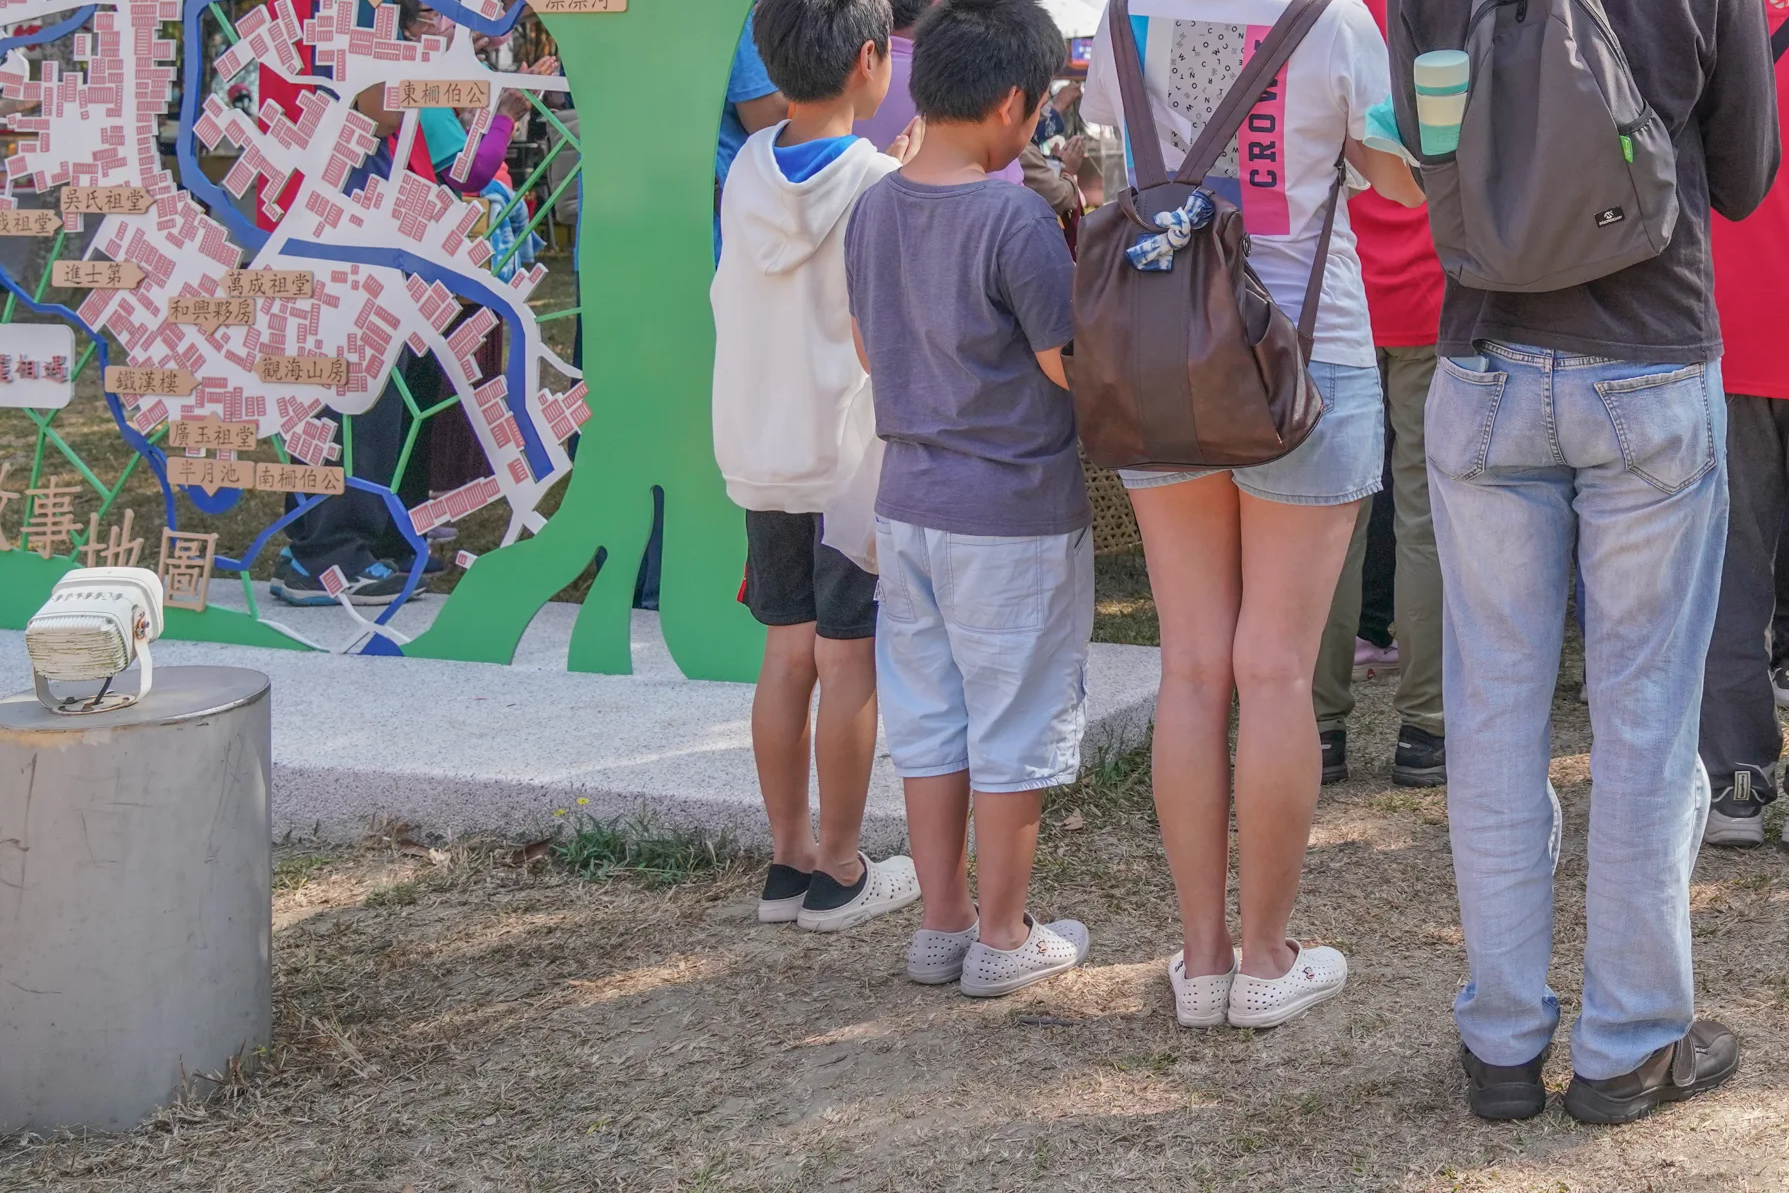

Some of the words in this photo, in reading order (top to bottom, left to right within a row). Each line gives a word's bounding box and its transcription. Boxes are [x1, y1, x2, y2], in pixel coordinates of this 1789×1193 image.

[400, 81, 486, 106] 東柵伯公
[63, 189, 145, 212] 吳氏祖堂
[64, 263, 122, 286] 進士第
[227, 271, 310, 296] 萬成祖堂
[170, 299, 253, 324] 和興夥房
[115, 370, 179, 394] 鐵漢樓
[262, 356, 345, 383] 觀海山房
[171, 422, 254, 448] 廣玉祖堂
[178, 459, 241, 484] 半月池
[258, 466, 342, 491] 南柵伯公
